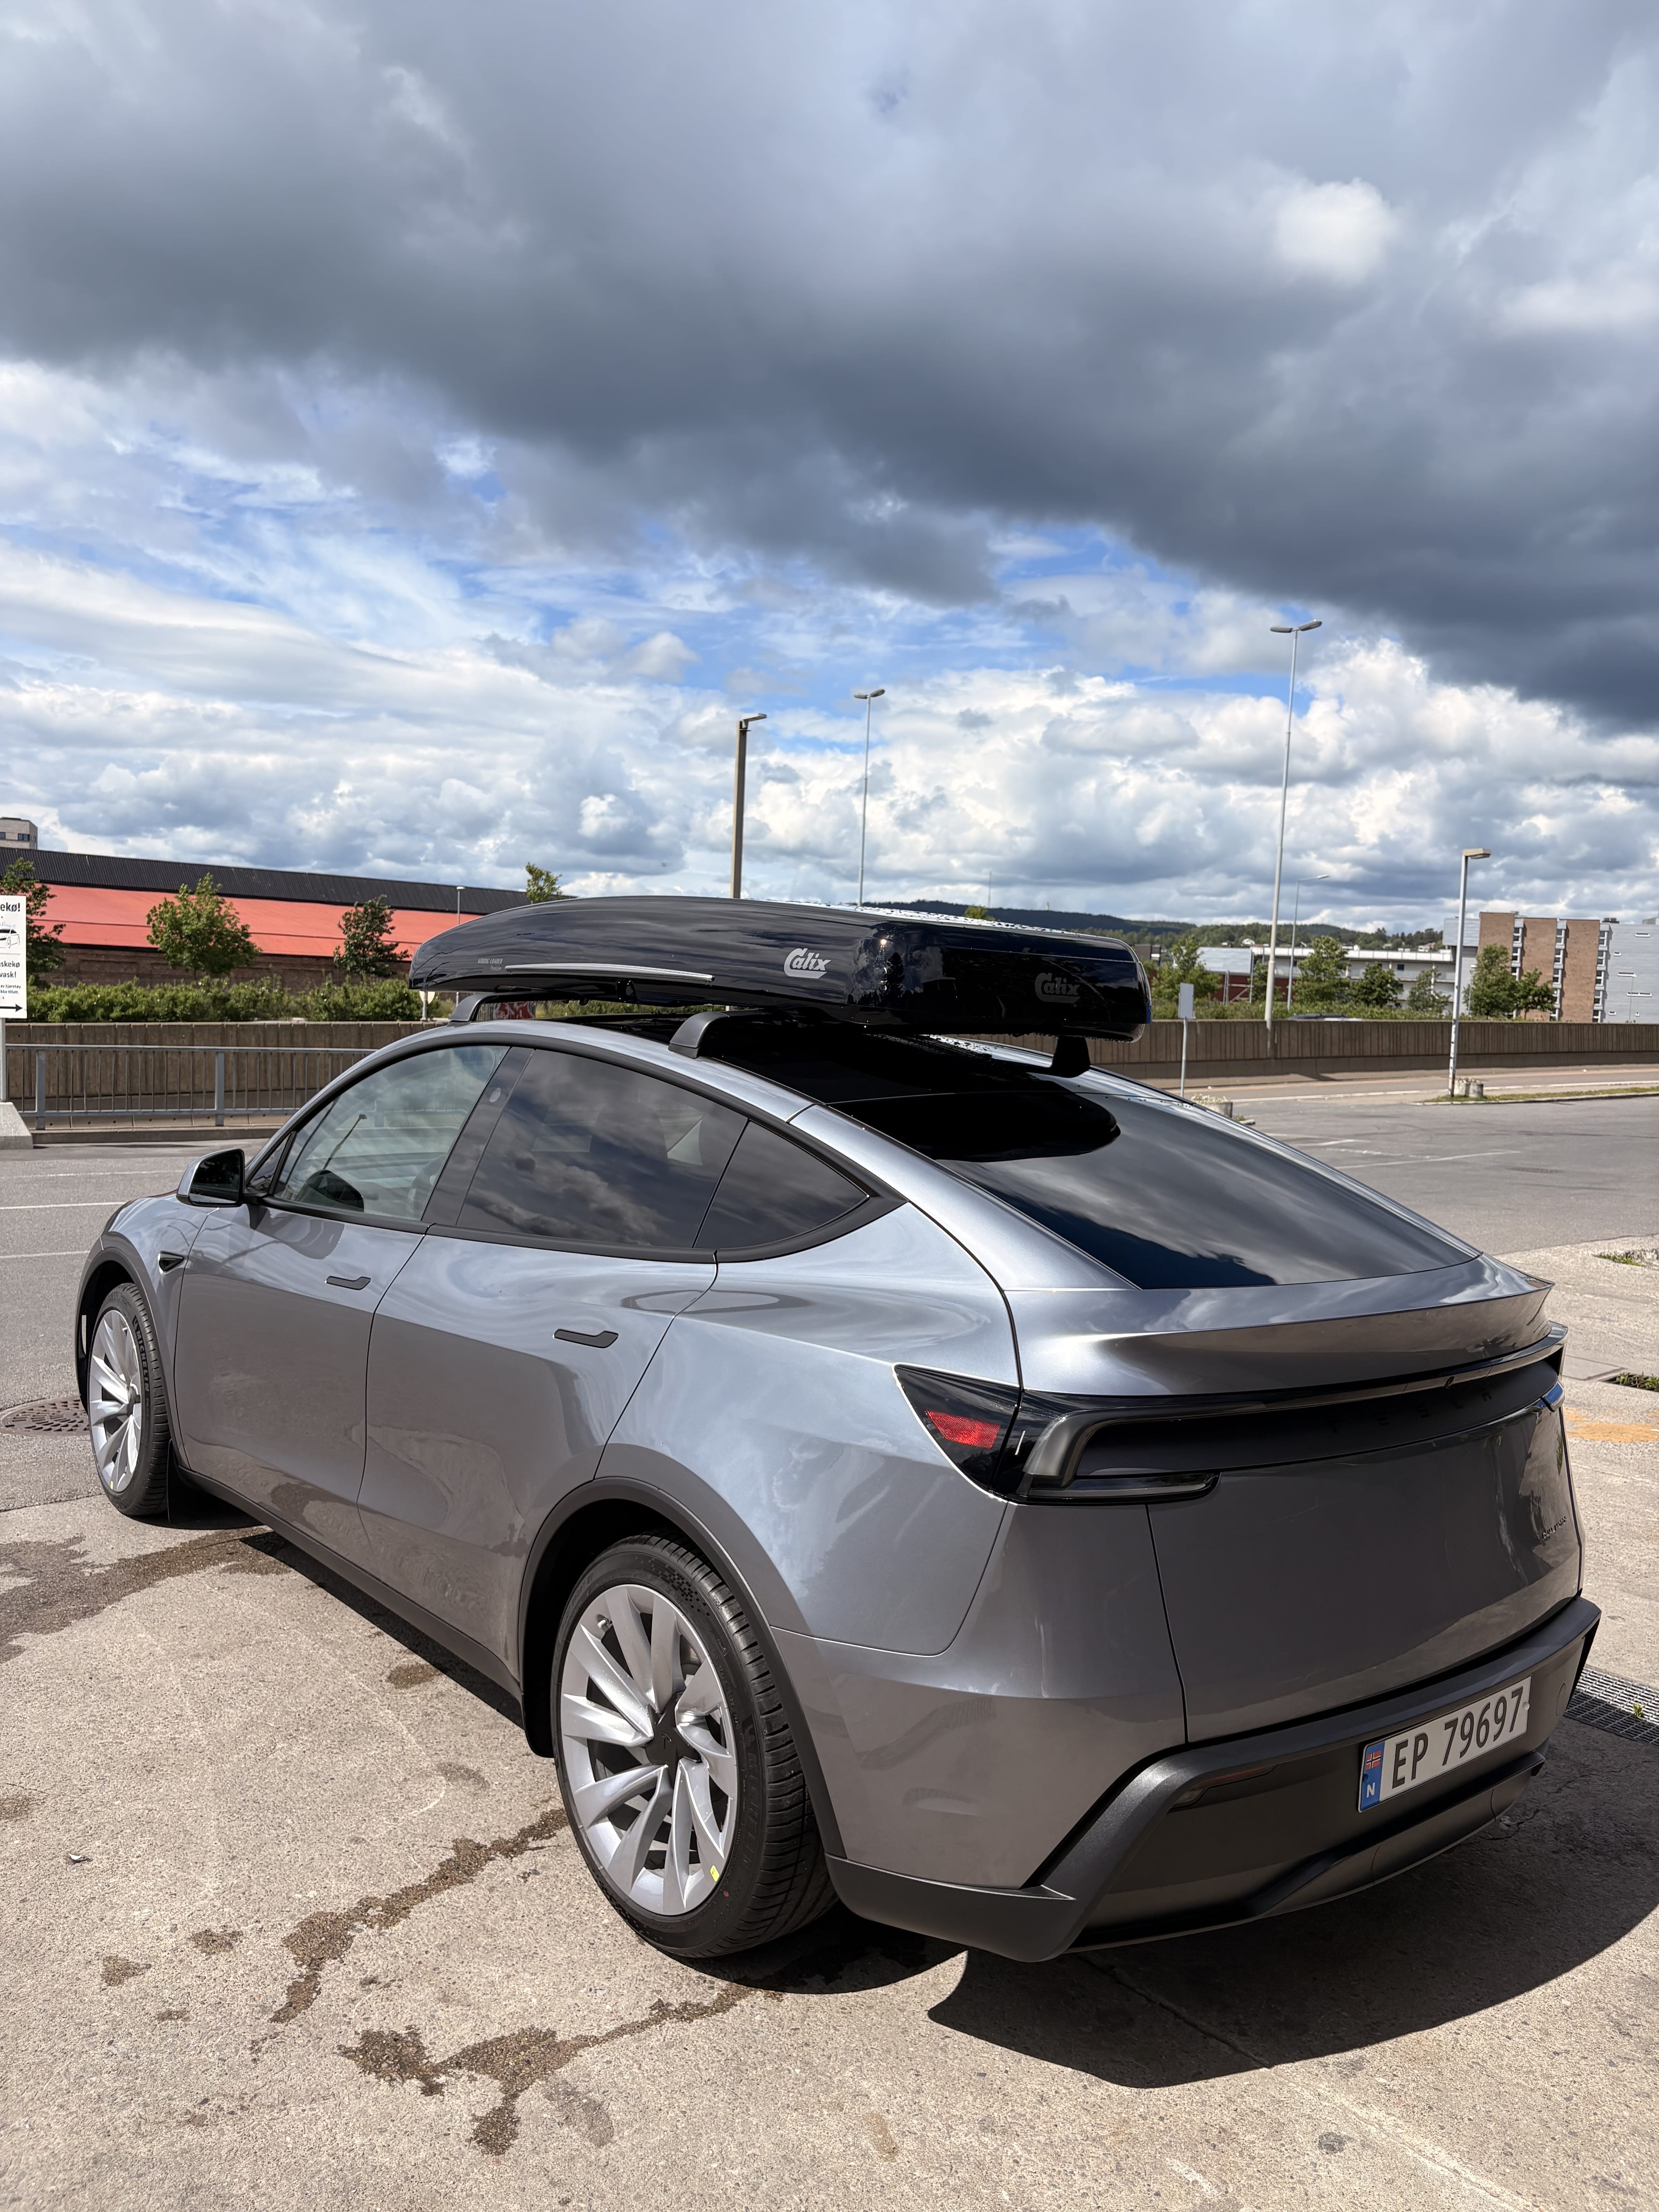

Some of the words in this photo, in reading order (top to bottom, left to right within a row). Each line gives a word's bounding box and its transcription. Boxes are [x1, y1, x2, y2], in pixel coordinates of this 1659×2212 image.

[784, 948, 832, 979] Calix
[1035, 973, 1080, 1003] Calix
[136, 1330, 149, 1392] MICHELIN
[1392, 1731, 1429, 1789] EP
[1442, 1686, 1524, 1766] 79697
[1366, 1782, 1376, 1798] N
